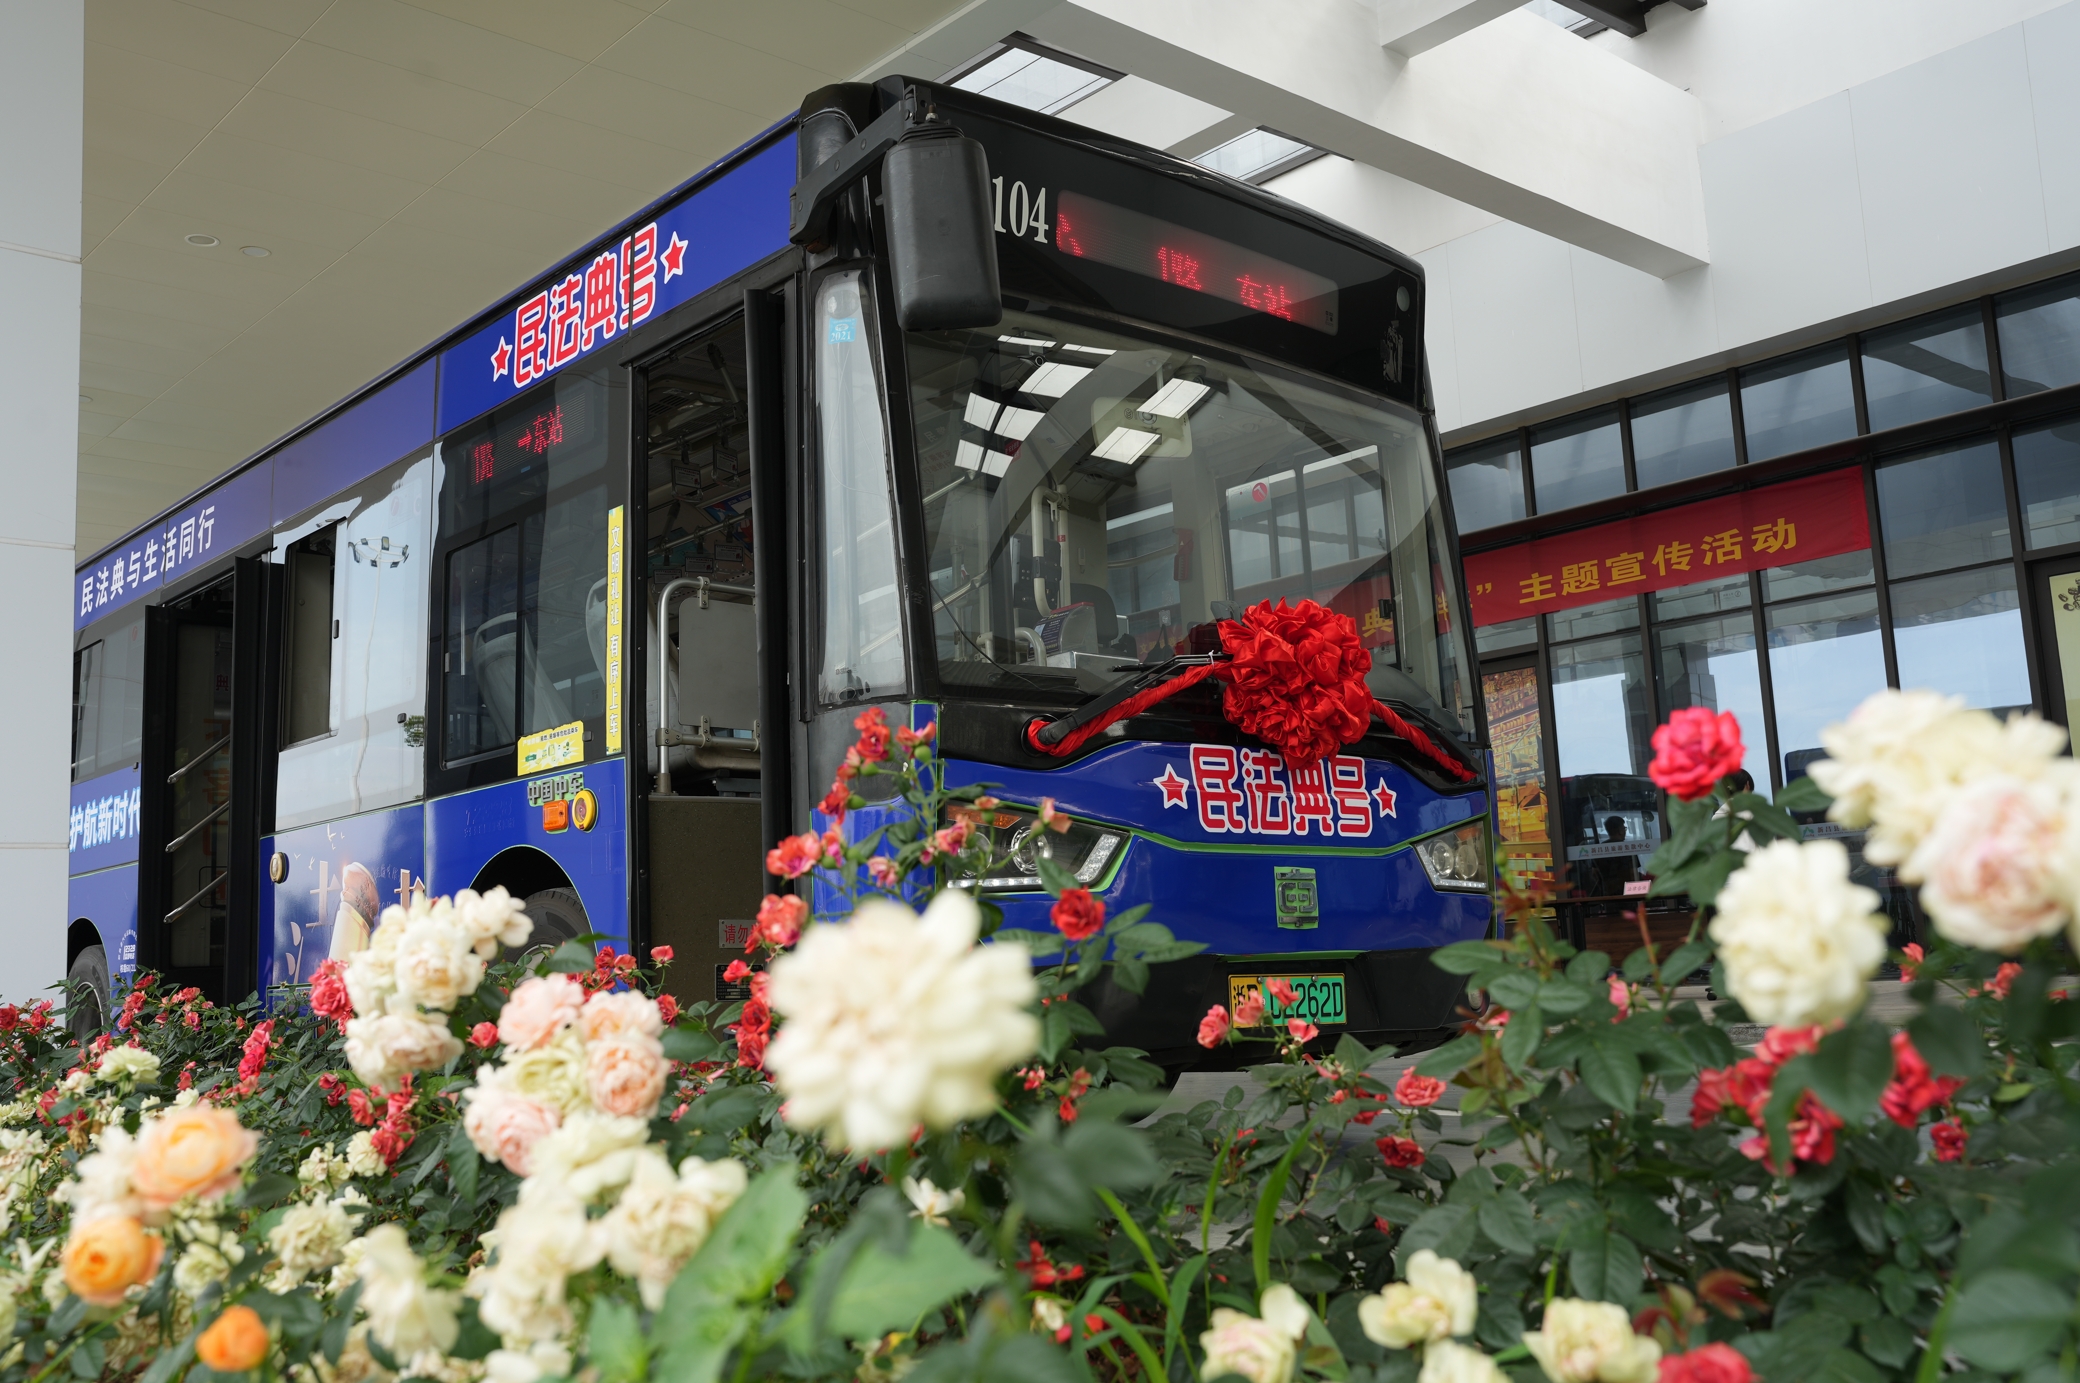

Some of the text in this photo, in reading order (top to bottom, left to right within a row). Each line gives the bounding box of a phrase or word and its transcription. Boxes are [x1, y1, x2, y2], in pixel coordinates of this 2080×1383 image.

[992, 175, 1049, 244] 104
[513, 222, 657, 389] 民法典号
[830, 331, 851, 342] 2021
[533, 405, 564, 455] 东站
[80, 505, 215, 618] 民法典与生活同行
[610, 525, 621, 627] 文明礼让
[1518, 517, 1798, 604] 主题宣传活动
[609, 633, 620, 738] 有序上车
[69, 786, 141, 854] 护航新时代
[527, 773, 584, 806] 中国中车
[1190, 744, 1373, 838] 民法典号
[724, 923, 756, 945] 请勿
